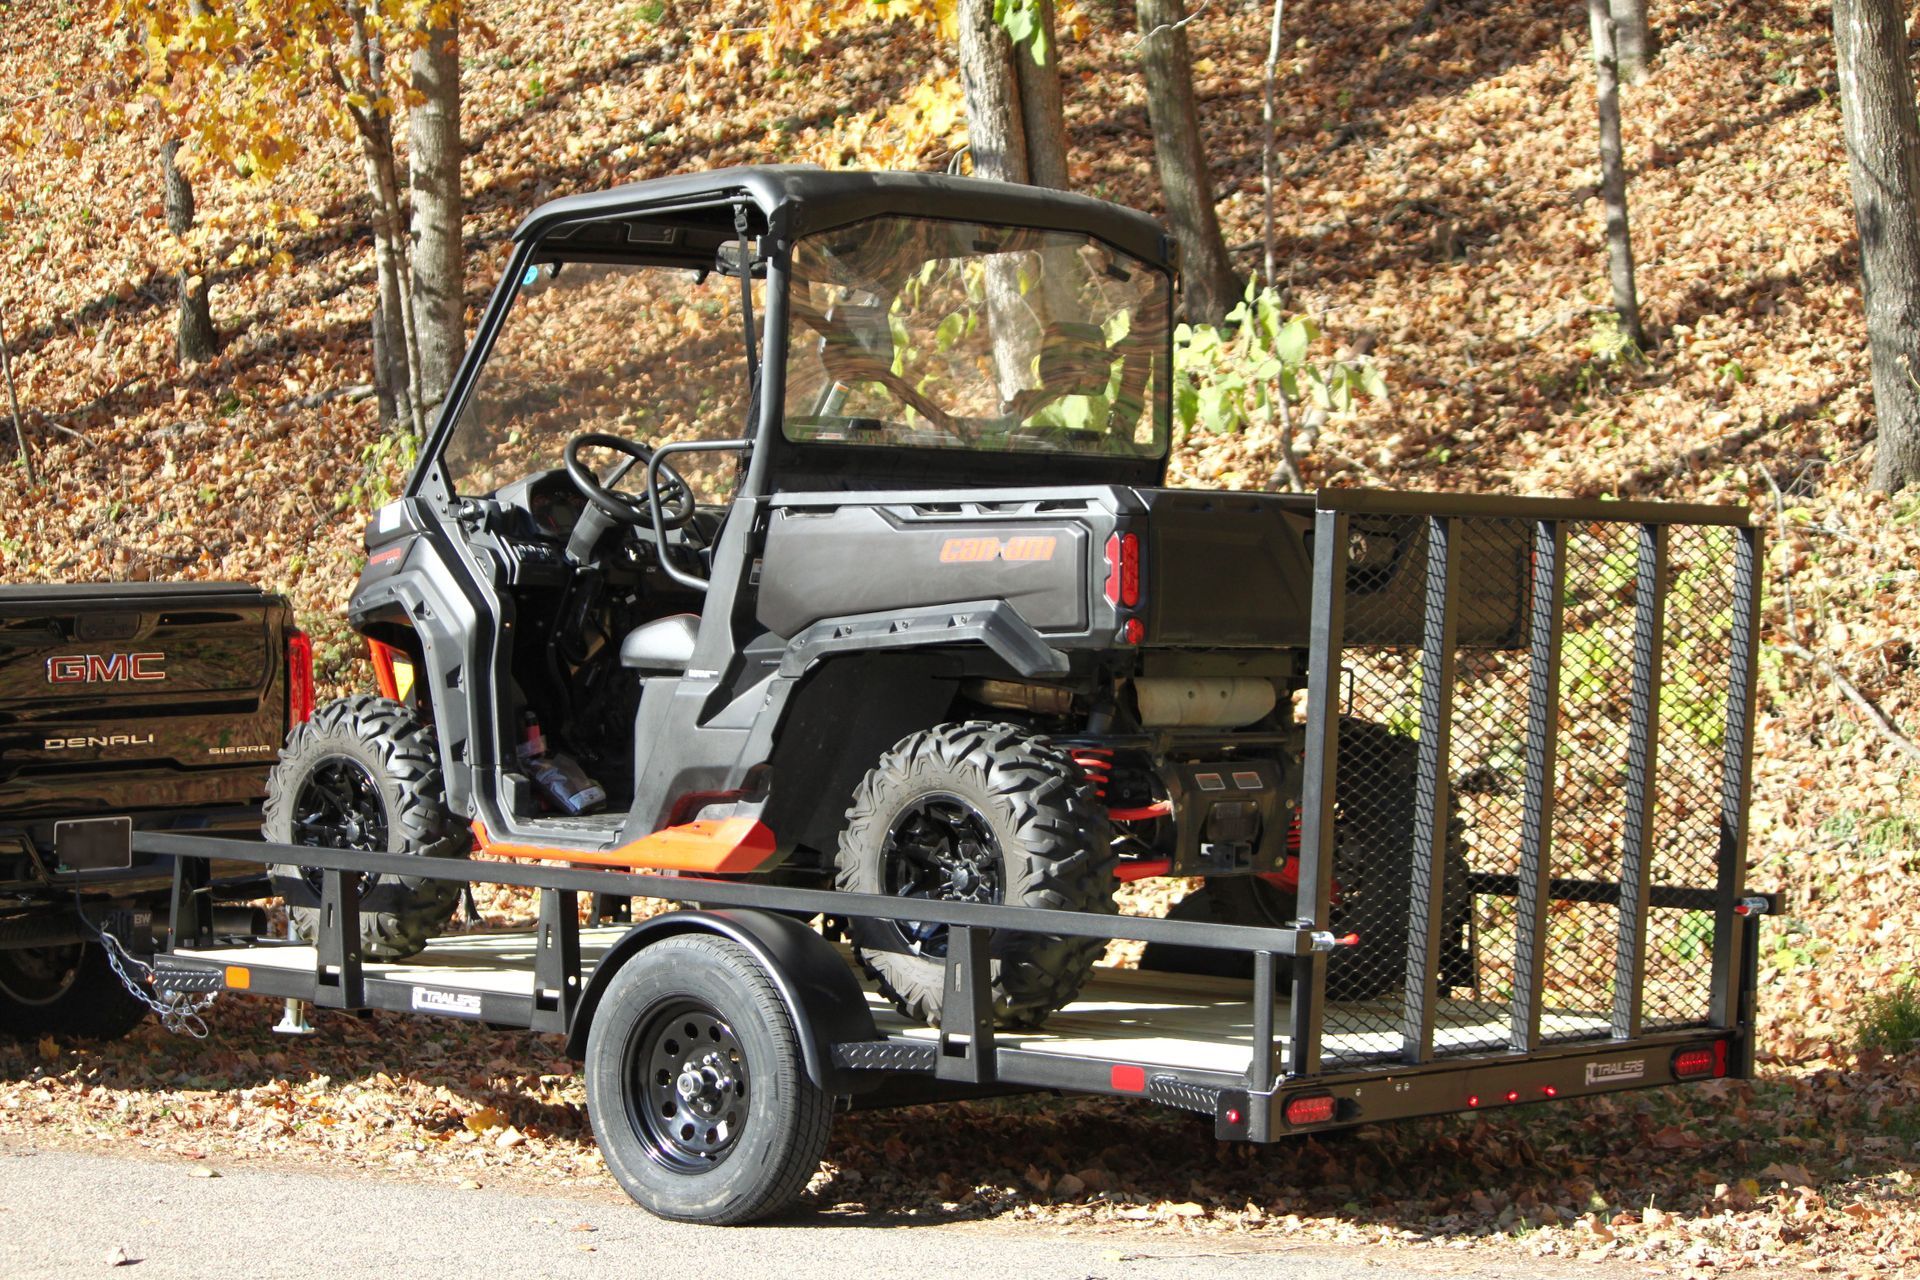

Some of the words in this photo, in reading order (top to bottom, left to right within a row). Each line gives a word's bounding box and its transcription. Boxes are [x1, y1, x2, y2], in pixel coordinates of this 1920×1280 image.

[46, 652, 166, 684] GMC
[44, 733, 154, 750] DENALI
[208, 745, 271, 755] SIERRA
[1597, 1059, 1645, 1076] TRAILERS
